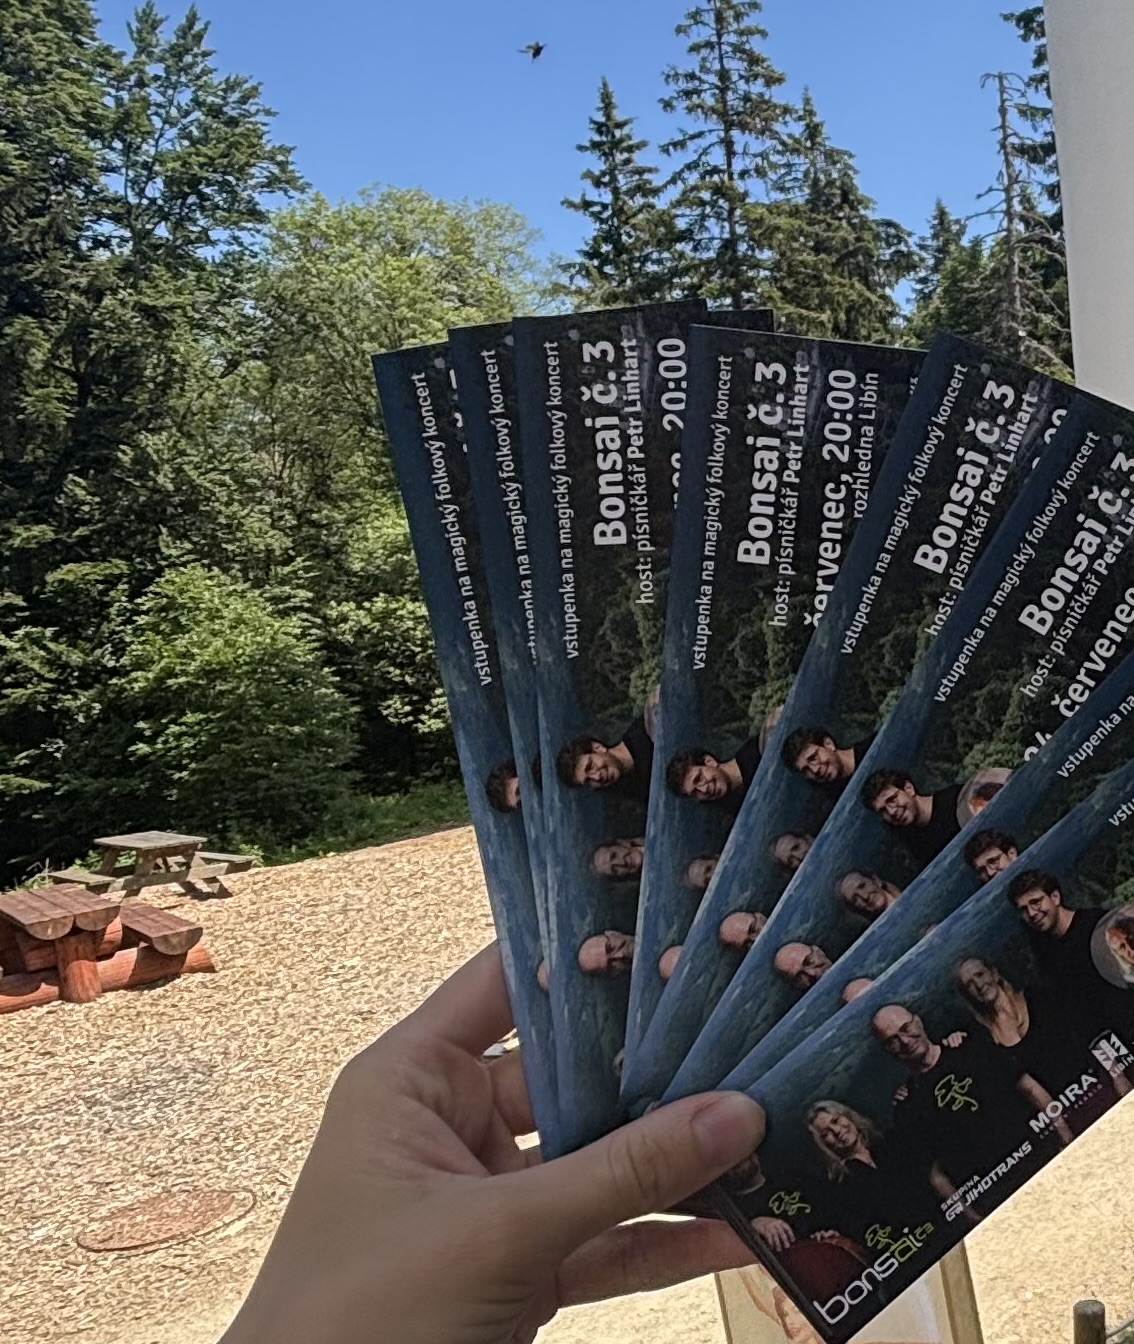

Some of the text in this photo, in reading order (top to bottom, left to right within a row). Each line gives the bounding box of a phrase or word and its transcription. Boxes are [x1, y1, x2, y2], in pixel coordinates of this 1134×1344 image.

[480, 349, 505, 414] koncert
[490, 418, 516, 478] folkový
[580, 340, 627, 546] Bonsai č. 3
[822, 369, 857, 463] 20:00
[851, 373, 879, 518] rozhledna Libín
[411, 372, 492, 686] vstupenka na magický folkový koncert
[500, 482, 528, 551] magický
[543, 341, 581, 659] vstupenka na magický folkový koncert
[620, 338, 656, 604] host: písničkář Petr Linhart
[692, 355, 733, 670] vstupenka na magický folkový koncert
[736, 362, 787, 565] Bonsai č. 3
[768, 363, 810, 627] host: písničkář Petr Linhart
[840, 363, 968, 654] vstupenka na magický folkový koncert
[913, 380, 1015, 574] Bonsai č. 3
[923, 392, 1038, 636] host: písničkář Petr Linhart
[517, 554, 532, 575] na
[934, 627, 985, 702] vstupenka
[979, 606, 998, 628] na
[992, 542, 1036, 606] magický
[1025, 488, 1068, 544] folkový
[1056, 431, 1100, 490] koncert
[1018, 513, 1108, 636] Bonsai
[1087, 485, 1131, 516] č.
[1019, 654, 1056, 698] host:
[1050, 572, 1101, 656] písničkář
[1092, 535, 1125, 576] Petr
[1056, 713, 1122, 778] vstupenka
[965, 1141, 1032, 1207] JIHOTRANS
[1029, 1074, 1102, 1133] MOIRA
[940, 1175, 981, 1211] SKUPINA
[812, 1227, 923, 1325] bonsai
